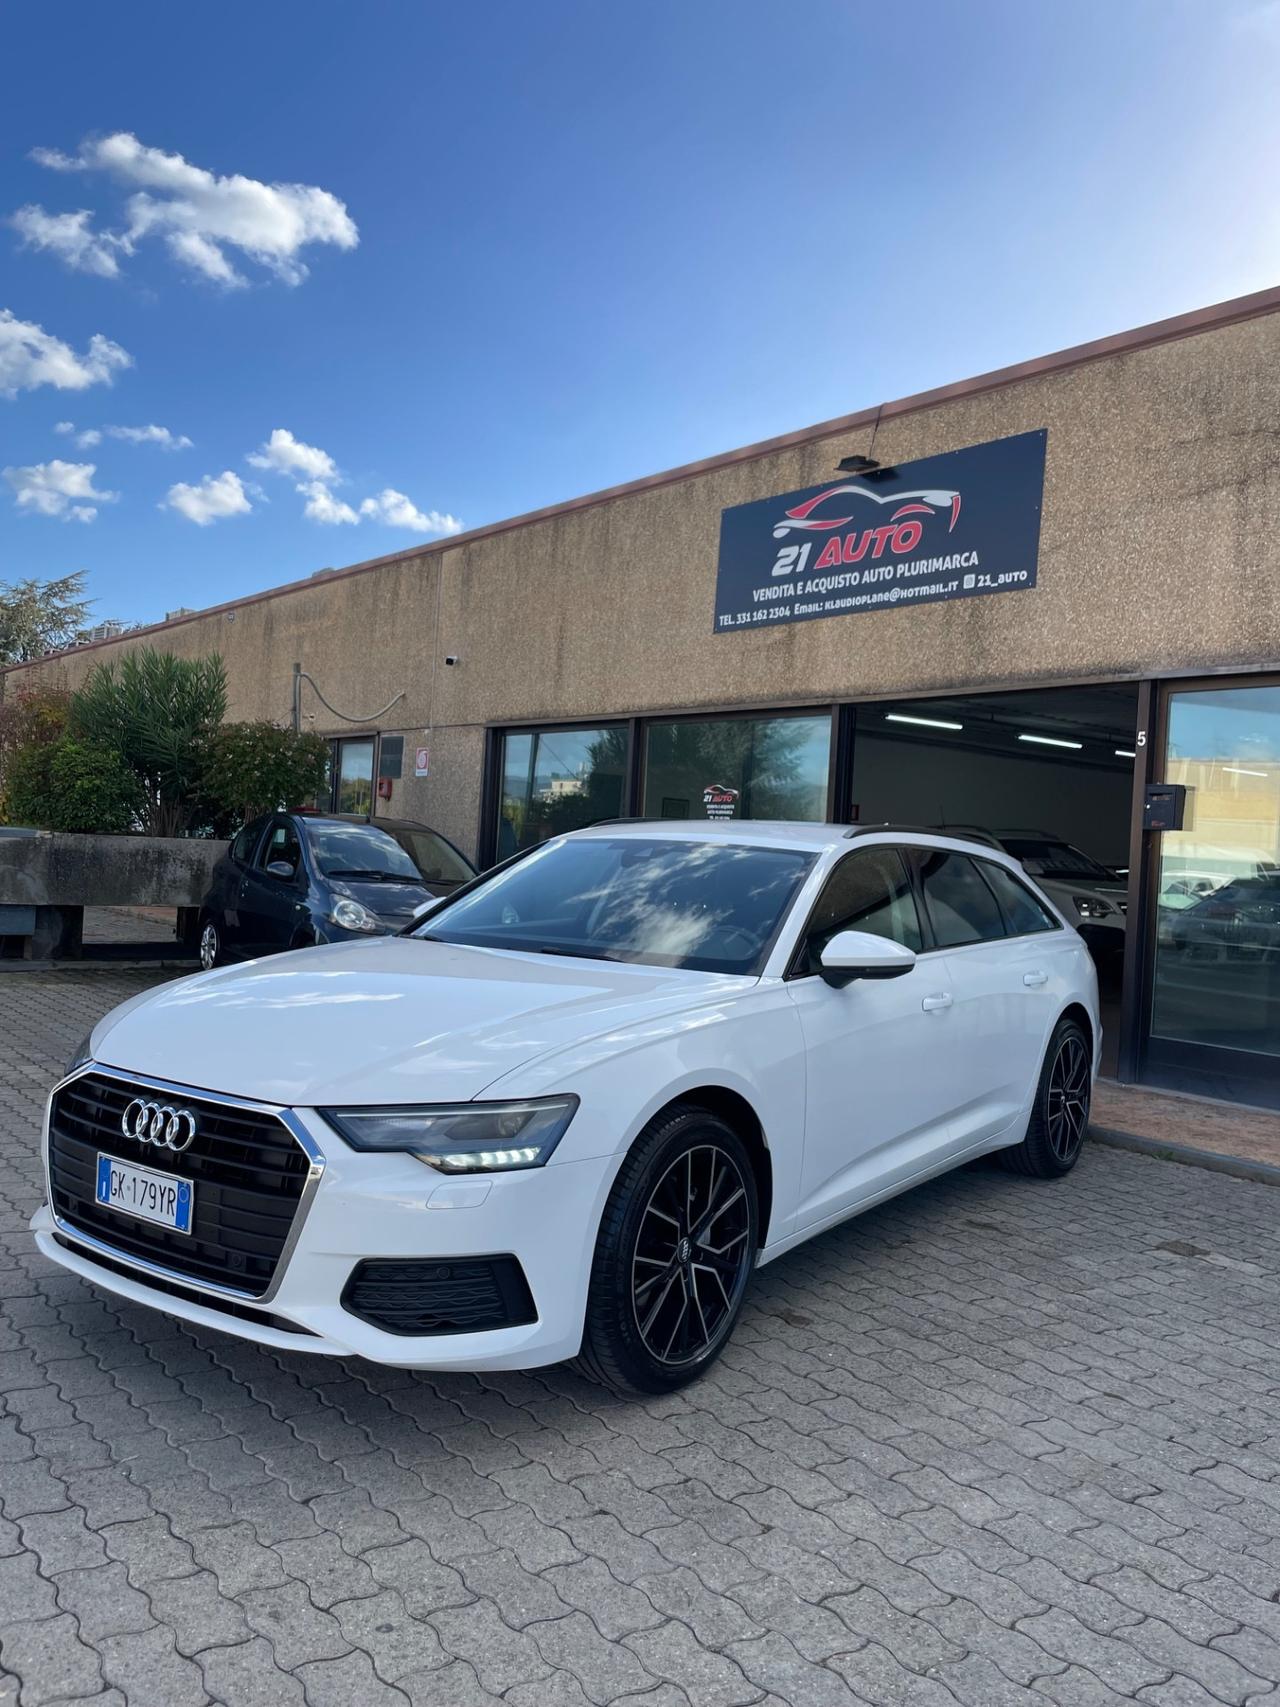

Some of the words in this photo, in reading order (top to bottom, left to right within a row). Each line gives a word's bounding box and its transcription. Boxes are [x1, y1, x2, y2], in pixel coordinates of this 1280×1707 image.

[771, 542, 812, 576] 21
[813, 520, 923, 570] AUTO
[752, 583, 795, 602] VENDITA
[796, 581, 804, 595] E
[804, 572, 860, 594] ACQUISTO
[861, 565, 894, 584] AUTO
[896, 551, 979, 578] PLURIMARCA
[719, 614, 735, 626] TEL.
[736, 611, 751, 625] 331
[752, 609, 767, 621] 162
[769, 605, 791, 618] 2304
[1137, 731, 1146, 746] 5
